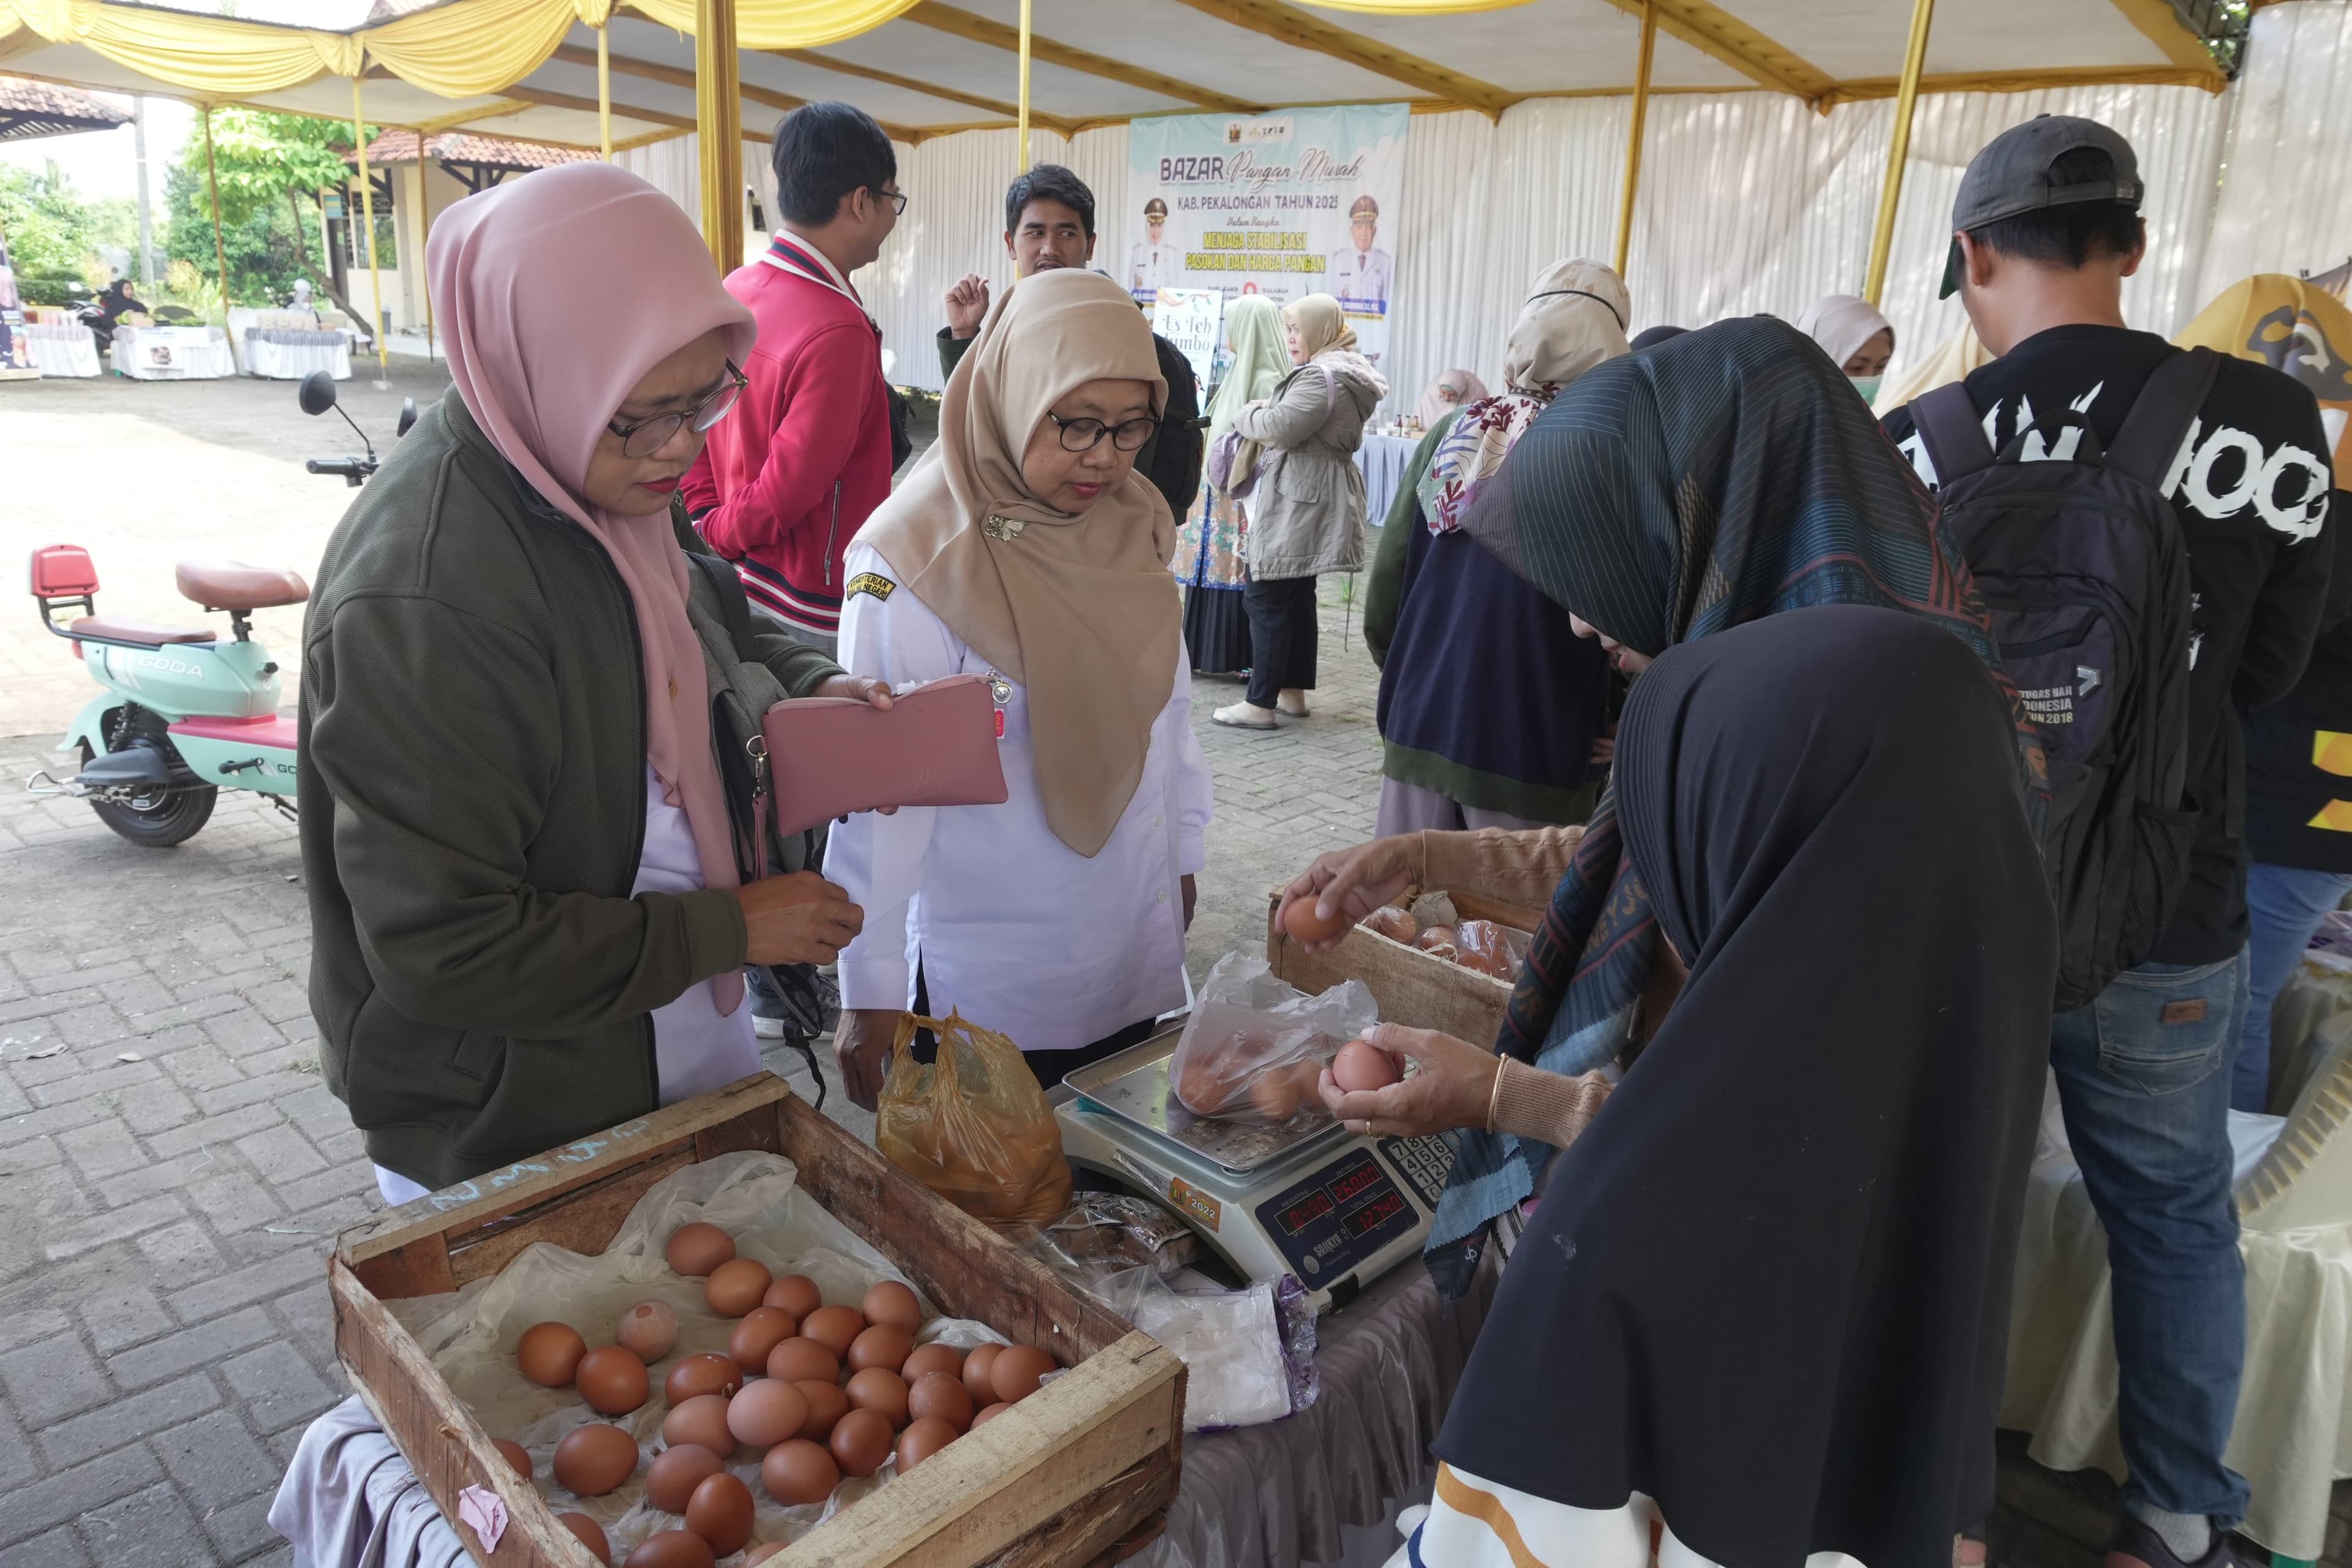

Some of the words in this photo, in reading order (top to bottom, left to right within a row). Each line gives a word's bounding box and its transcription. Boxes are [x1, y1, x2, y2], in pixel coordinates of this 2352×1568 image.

[1159, 157, 1224, 181] BAZAR
[1226, 150, 1291, 192] Pangan
[1297, 148, 1364, 182] Murah
[1177, 197, 1199, 210] KAB.
[1201, 196, 1270, 209] PEKALONGAN
[1275, 195, 1313, 209] TAHUN
[1316, 195, 1338, 208] 2025
[1204, 232, 1245, 250] MENJAGA
[1247, 232, 1307, 251] STABILISASI
[1185, 252, 1226, 270] PASOKAN
[1227, 253, 1246, 271] DAN
[1248, 254, 1282, 272] HARGA
[1284, 254, 1325, 273] PANGAN
[1163, 315, 1180, 331] Es
[1186, 317, 1212, 334] Teh
[864, 582, 888, 598] NEGERI
[138, 655, 205, 679] GODA
[2018, 688, 2051, 699] TUGAS
[2052, 685, 2073, 697] HAJI
[2022, 698, 2073, 711] DONESIA
[2046, 712, 2073, 724] 2018
[1408, 1137, 1419, 1148] 8
[1434, 1142, 1444, 1153] 6
[1392, 1144, 1403, 1156] 7
[1419, 1150, 1431, 1162] 5
[1408, 1158, 1418, 1169] 4
[1431, 1164, 1444, 1177] 2
[1418, 1172, 1428, 1183] 1
[1191, 1198, 1216, 1219] 2022
[1351, 1199, 1365, 1210] TOTAL
[1313, 1233, 1342, 1257] SOJIKYO
